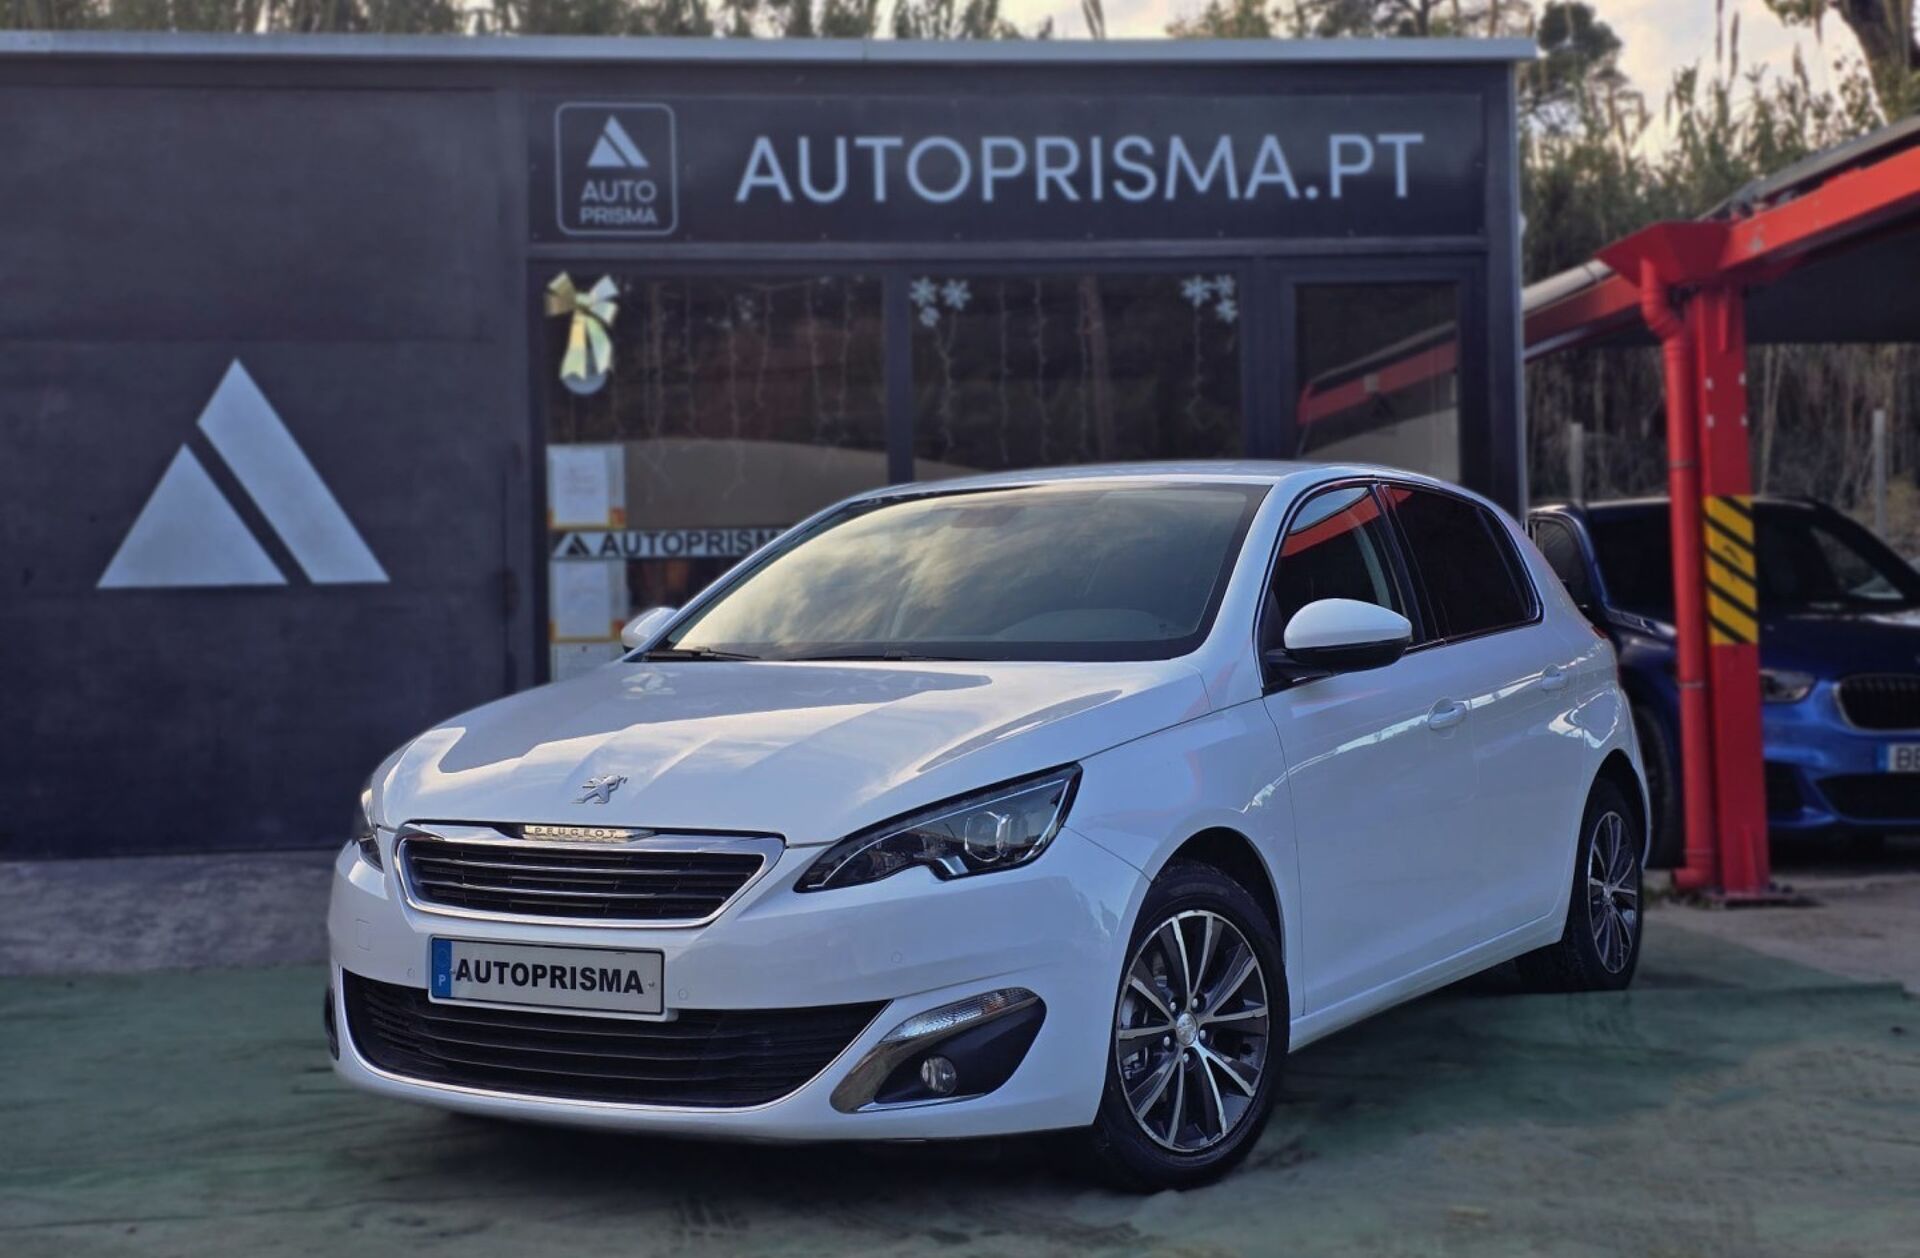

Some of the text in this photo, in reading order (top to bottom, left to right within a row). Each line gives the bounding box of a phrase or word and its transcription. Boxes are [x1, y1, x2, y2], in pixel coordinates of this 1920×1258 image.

[735, 132, 1425, 203] AUTOPRISMA.PT
[582, 180, 657, 202] AUTO
[580, 207, 657, 224] PRISMA
[534, 826, 618, 839] PEUGEOT
[438, 973, 447, 987] P
[455, 958, 645, 994] AUTOPRISMA
